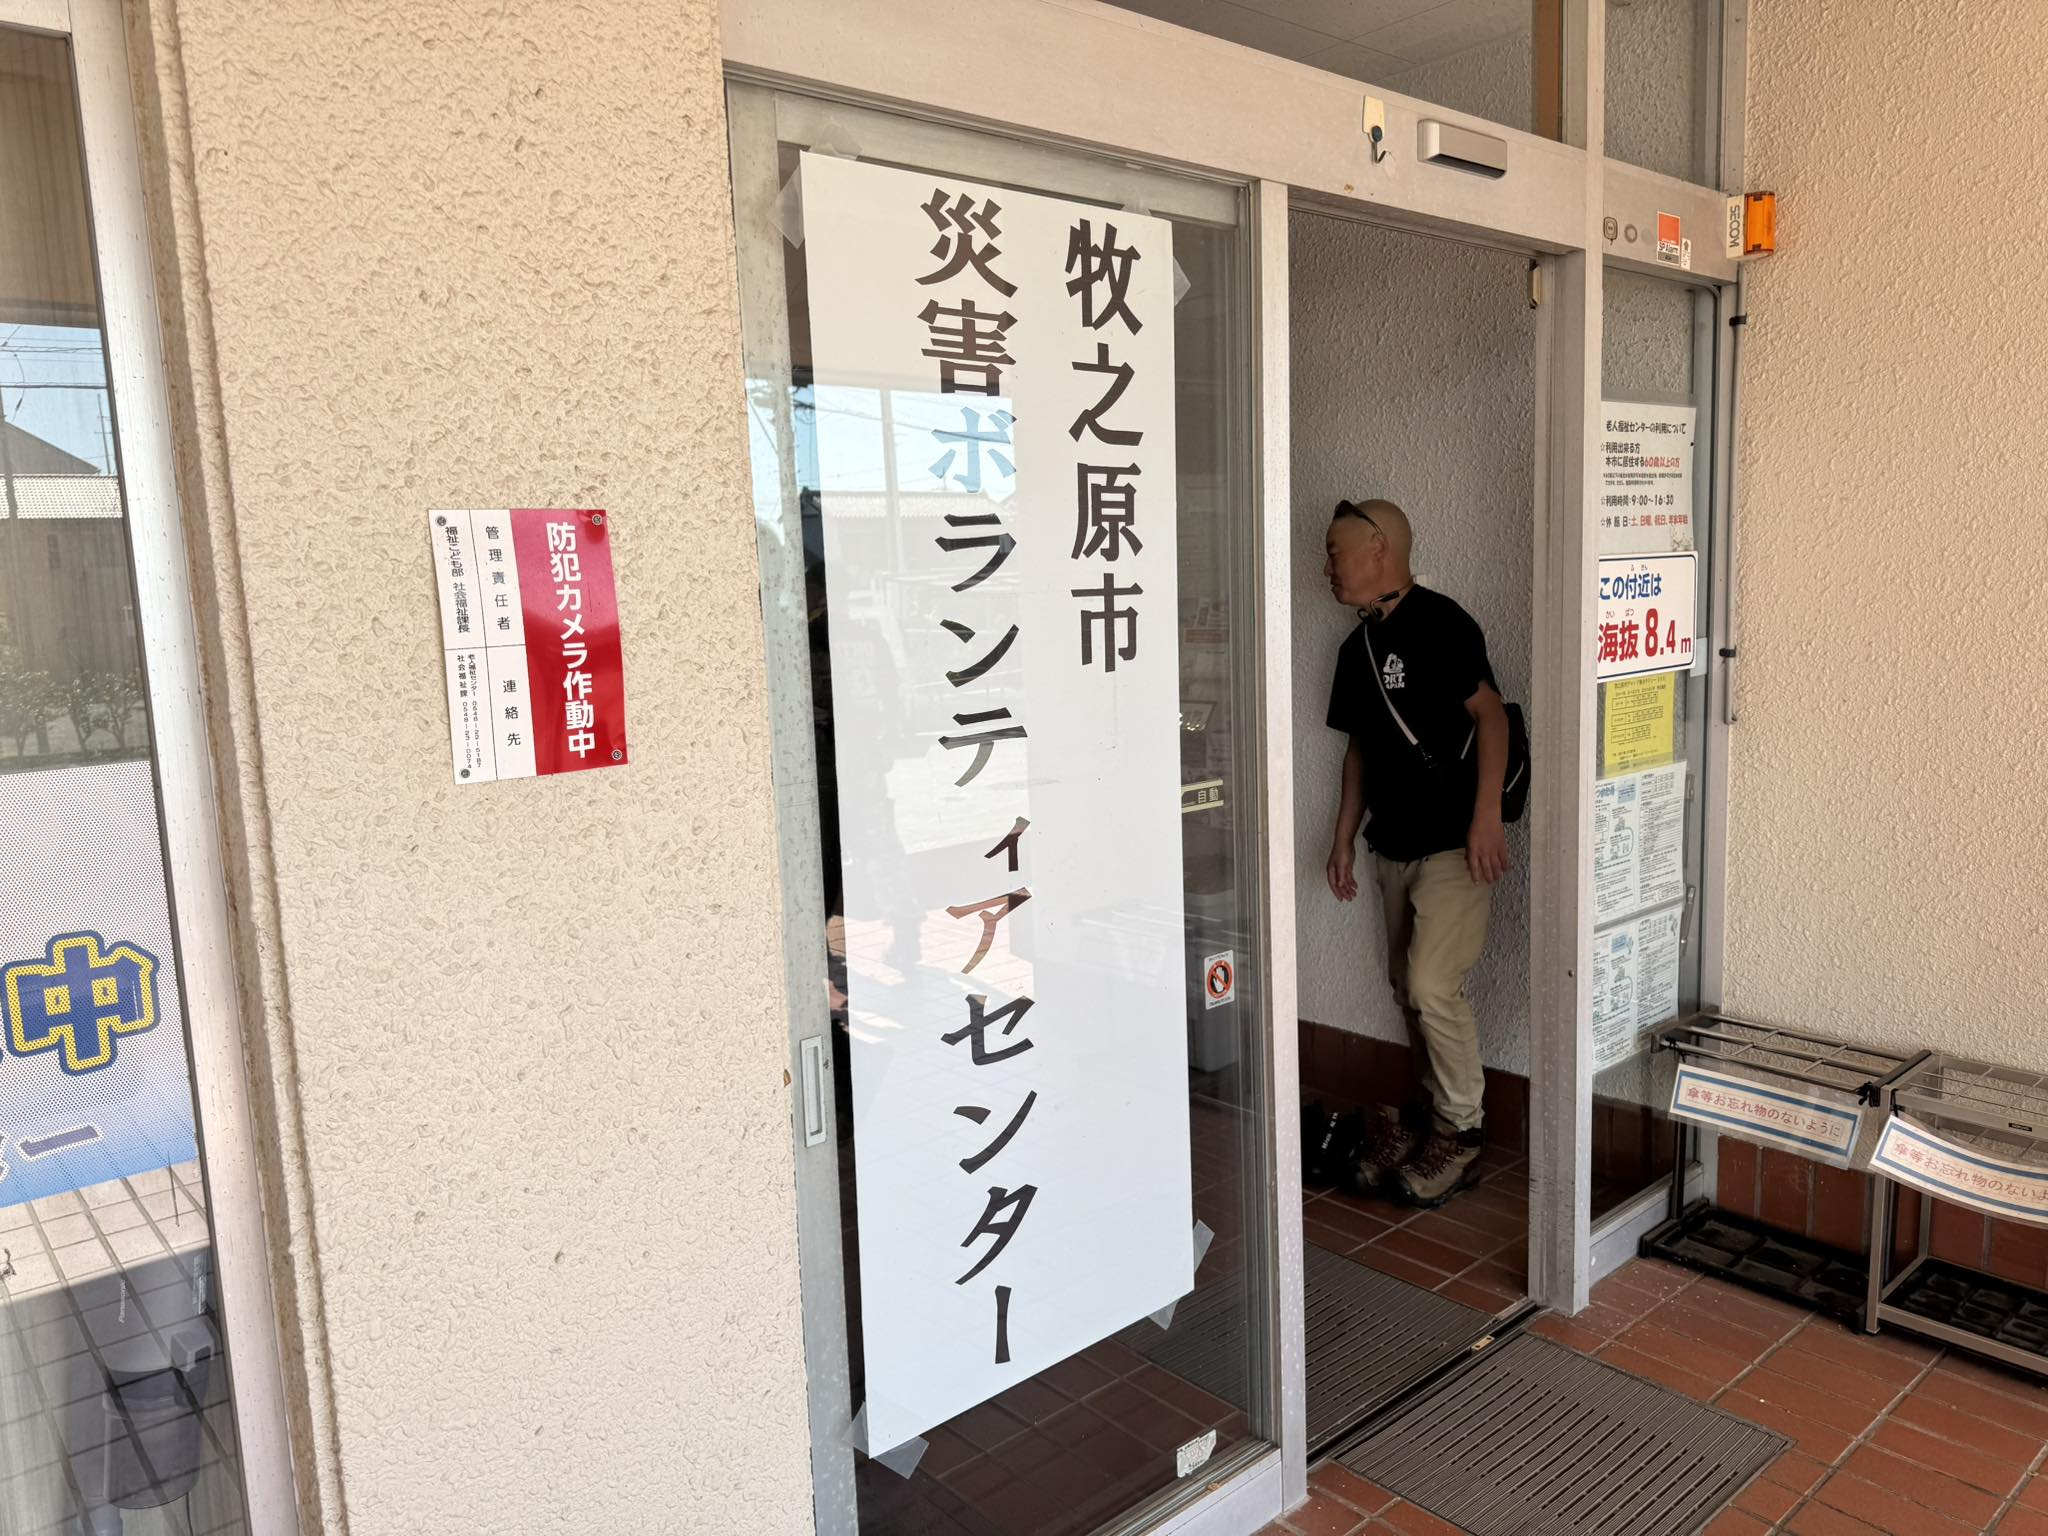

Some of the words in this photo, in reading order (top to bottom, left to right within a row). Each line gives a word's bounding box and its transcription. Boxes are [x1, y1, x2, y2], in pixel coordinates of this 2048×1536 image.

[1728, 204, 1741, 249] SECOM
[1064, 217, 1144, 674] 牧之原市
[445, 525, 465, 577] 福祉こども部
[485, 525, 510, 631] 管理責任者
[452, 582, 471, 633] 社会福祉課長
[1599, 573, 1662, 600] この付近は
[545, 521, 596, 759] 防犯カメラ作動中
[502, 679, 522, 747] 連絡先
[914, 187, 1039, 1365] 災害ボランティアセンター
[3, 930, 160, 1076] 中
[1687, 1087, 1842, 1139] 傘等お忘れ物のないように
